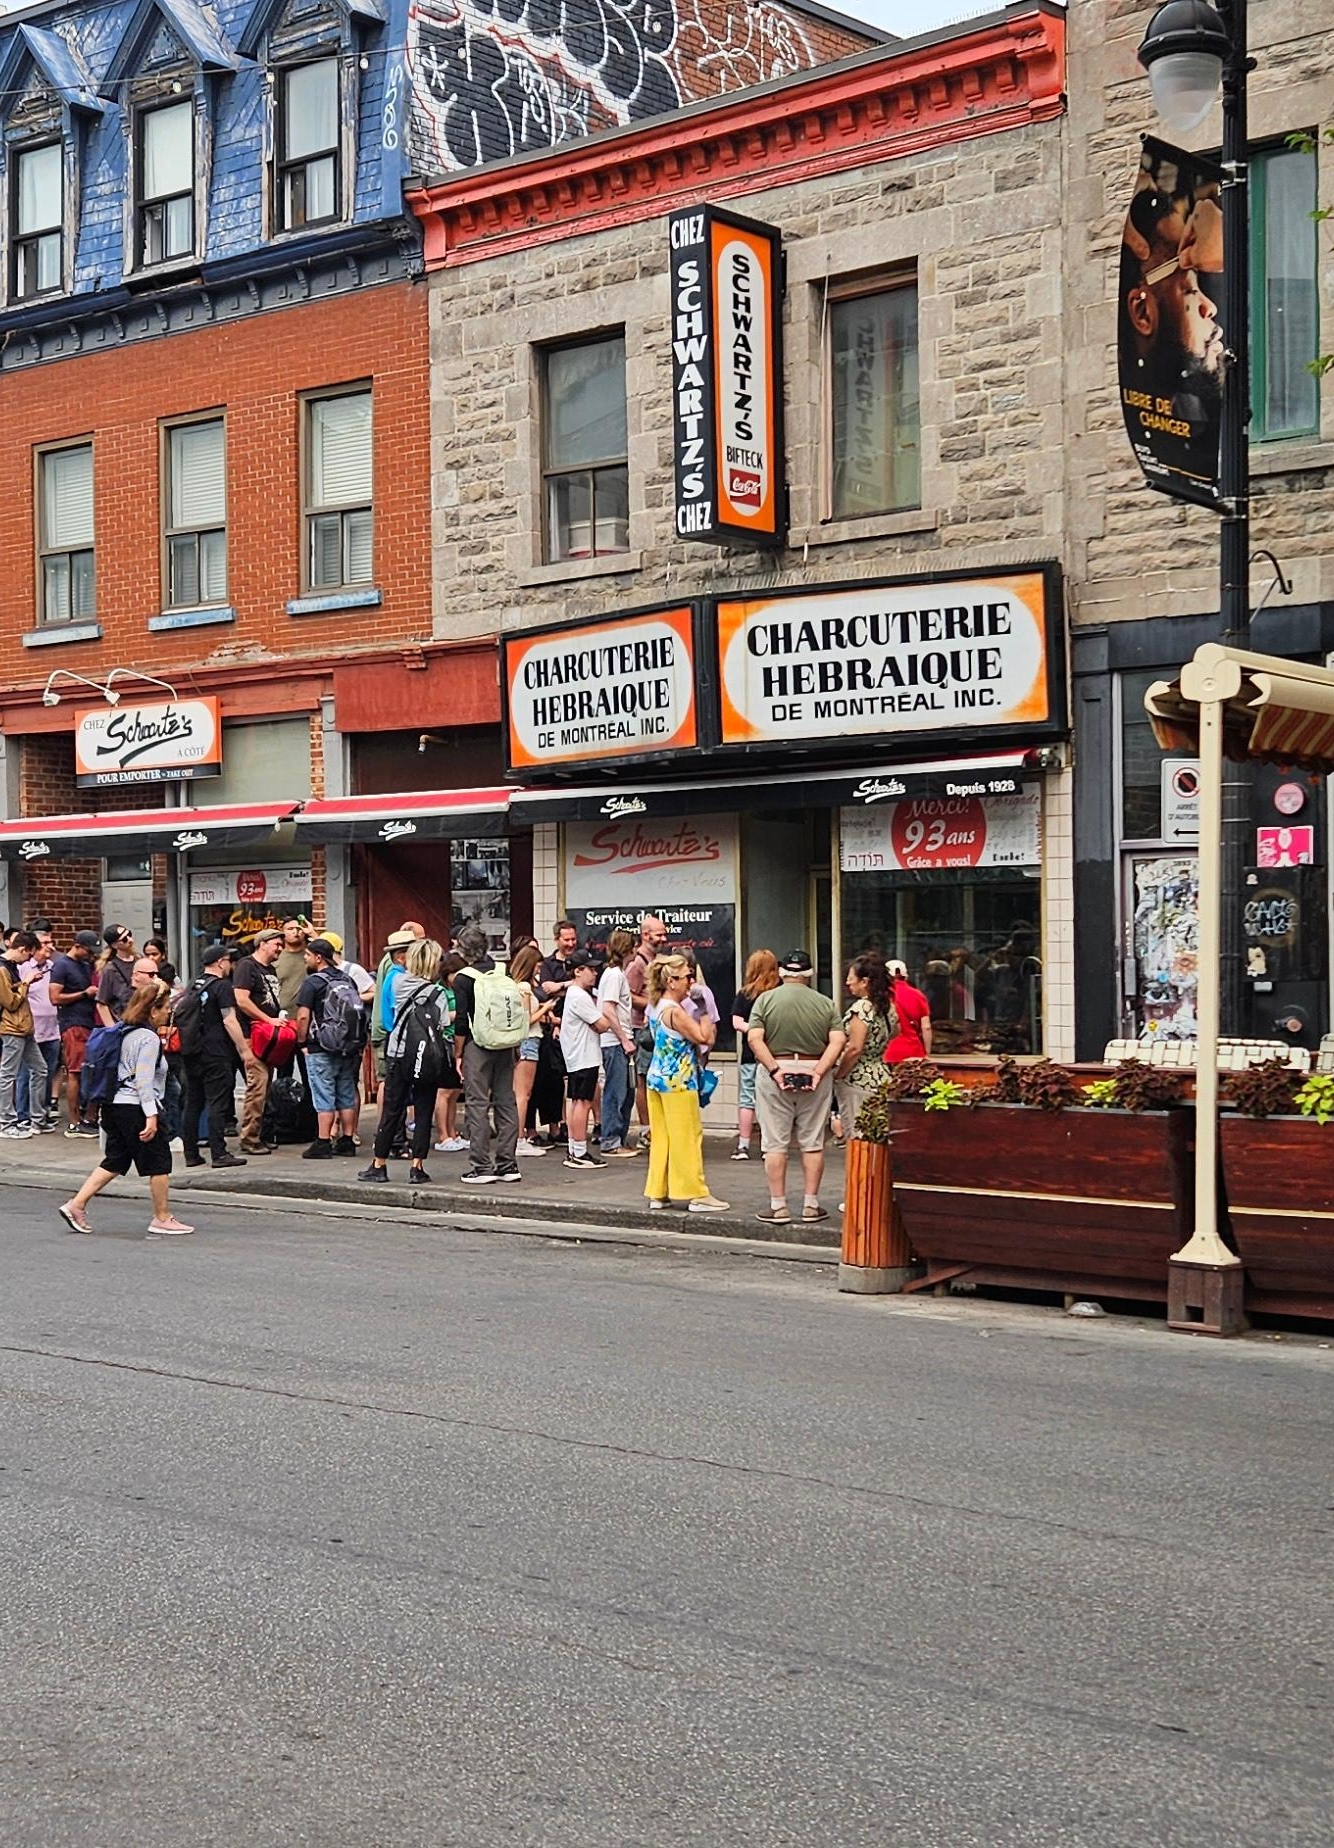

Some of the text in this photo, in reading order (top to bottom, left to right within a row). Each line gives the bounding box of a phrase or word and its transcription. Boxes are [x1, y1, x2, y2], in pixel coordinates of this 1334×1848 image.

[671, 214, 705, 250] CHEZ
[732, 254, 754, 441] SCHWARTZ'S
[673, 260, 708, 499] SCHWARTZ'S
[1123, 388, 1172, 415] LIBRE DE
[1139, 411, 1191, 438] CHANGER
[726, 445, 763, 470] BIFTECK
[678, 501, 712, 534] CHEZ
[747, 602, 1011, 656] CHARCUTERIE
[524, 636, 675, 690] CHARCUTERIE
[762, 647, 1003, 698] HEBRAIQUE
[533, 678, 670, 726] HEBRAIQUE
[772, 687, 1002, 722] DE MONTRÉAL INC.
[84, 704, 193, 769] CHEZ Schwartz's
[538, 716, 669, 748] DE MONTRÉAL INC.
[97, 774, 119, 784] POUR
[119, 769, 161, 782] EMPORTER
[182, 768, 194, 777] OUT
[946, 780, 1016, 797] Depuis 1928
[904, 799, 971, 820] Merci!
[574, 822, 721, 874] Schwartz's
[902, 819, 947, 855] 93
[946, 829, 976, 846] ans
[239, 883, 255, 896] 93
[586, 910, 633, 926] Service
[654, 908, 713, 923] Traiteur
[414, 1040, 426, 1079] HEAD
